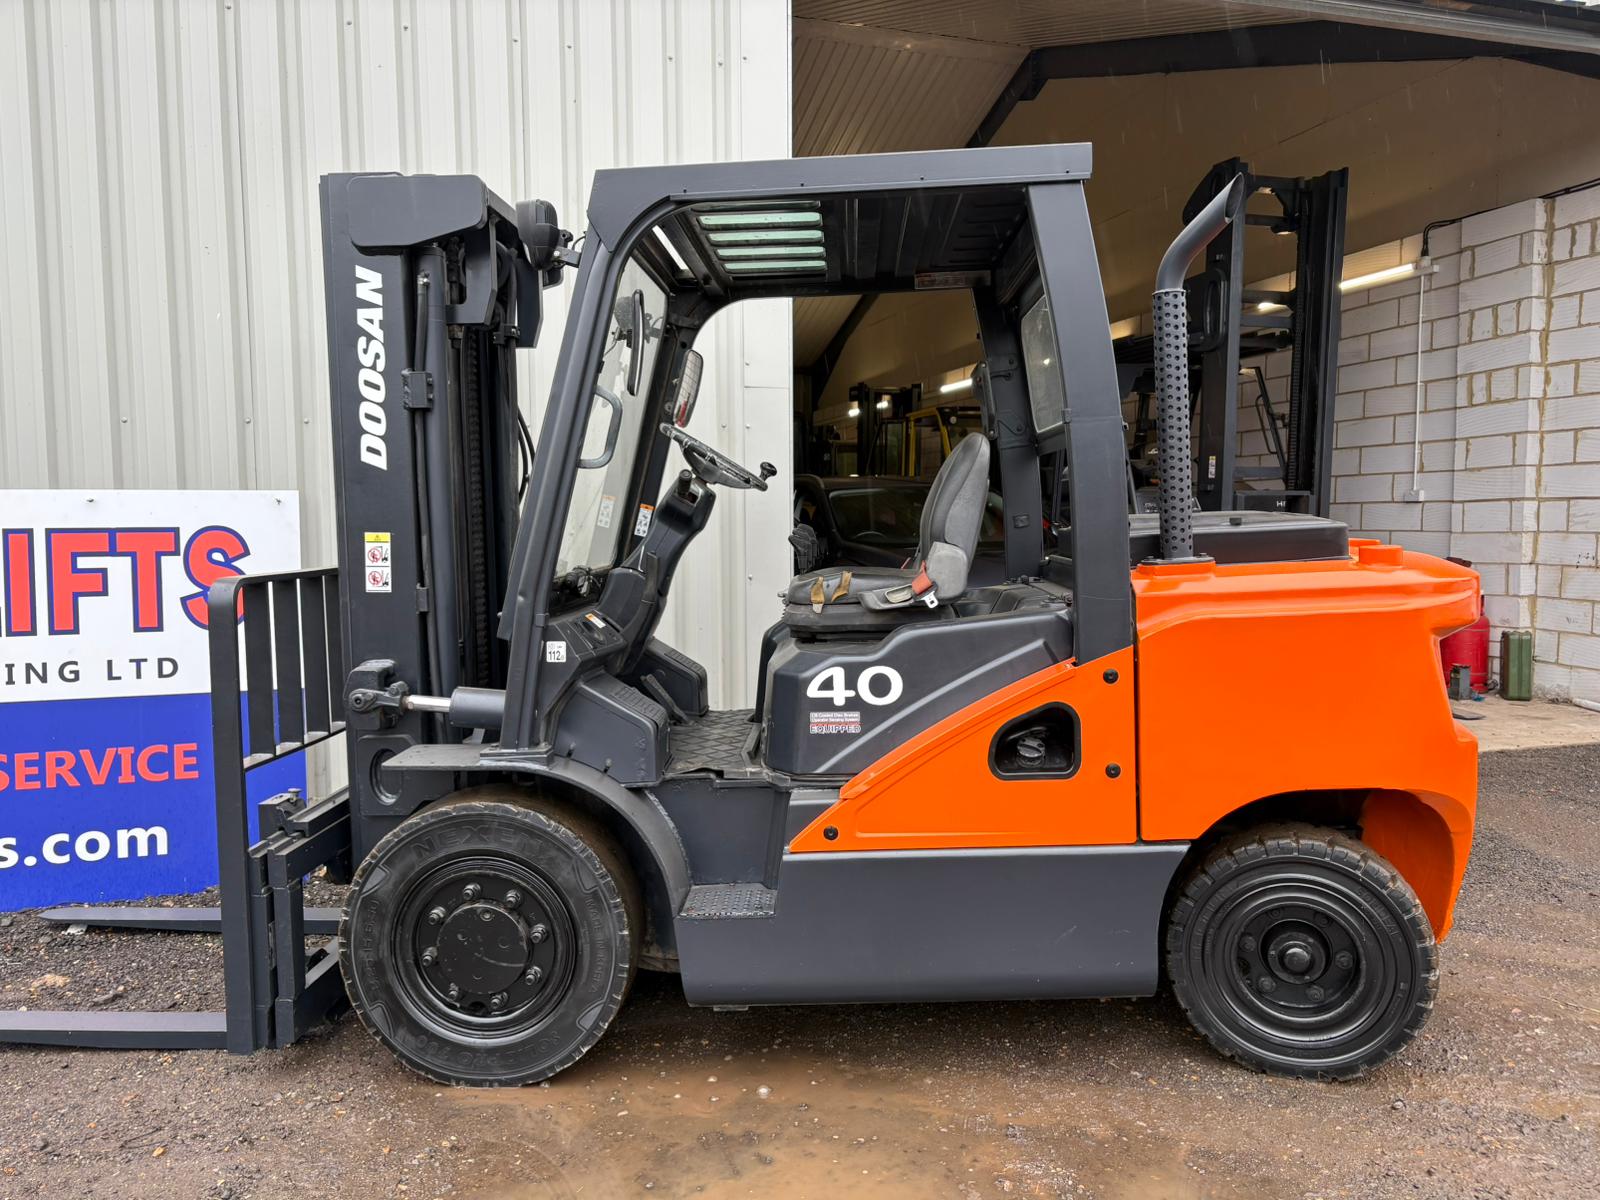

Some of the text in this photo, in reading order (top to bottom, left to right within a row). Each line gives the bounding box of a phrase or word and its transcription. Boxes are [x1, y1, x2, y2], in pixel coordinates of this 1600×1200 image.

[355, 264, 388, 471] DOOSAN
[0, 525, 251, 637] IFTS
[5, 657, 179, 685] ING LTD
[806, 665, 903, 706] 40
[810, 724, 861, 734] EQUIPPED
[0, 826, 168, 868] s.com
[411, 824, 544, 859] NEXEN
